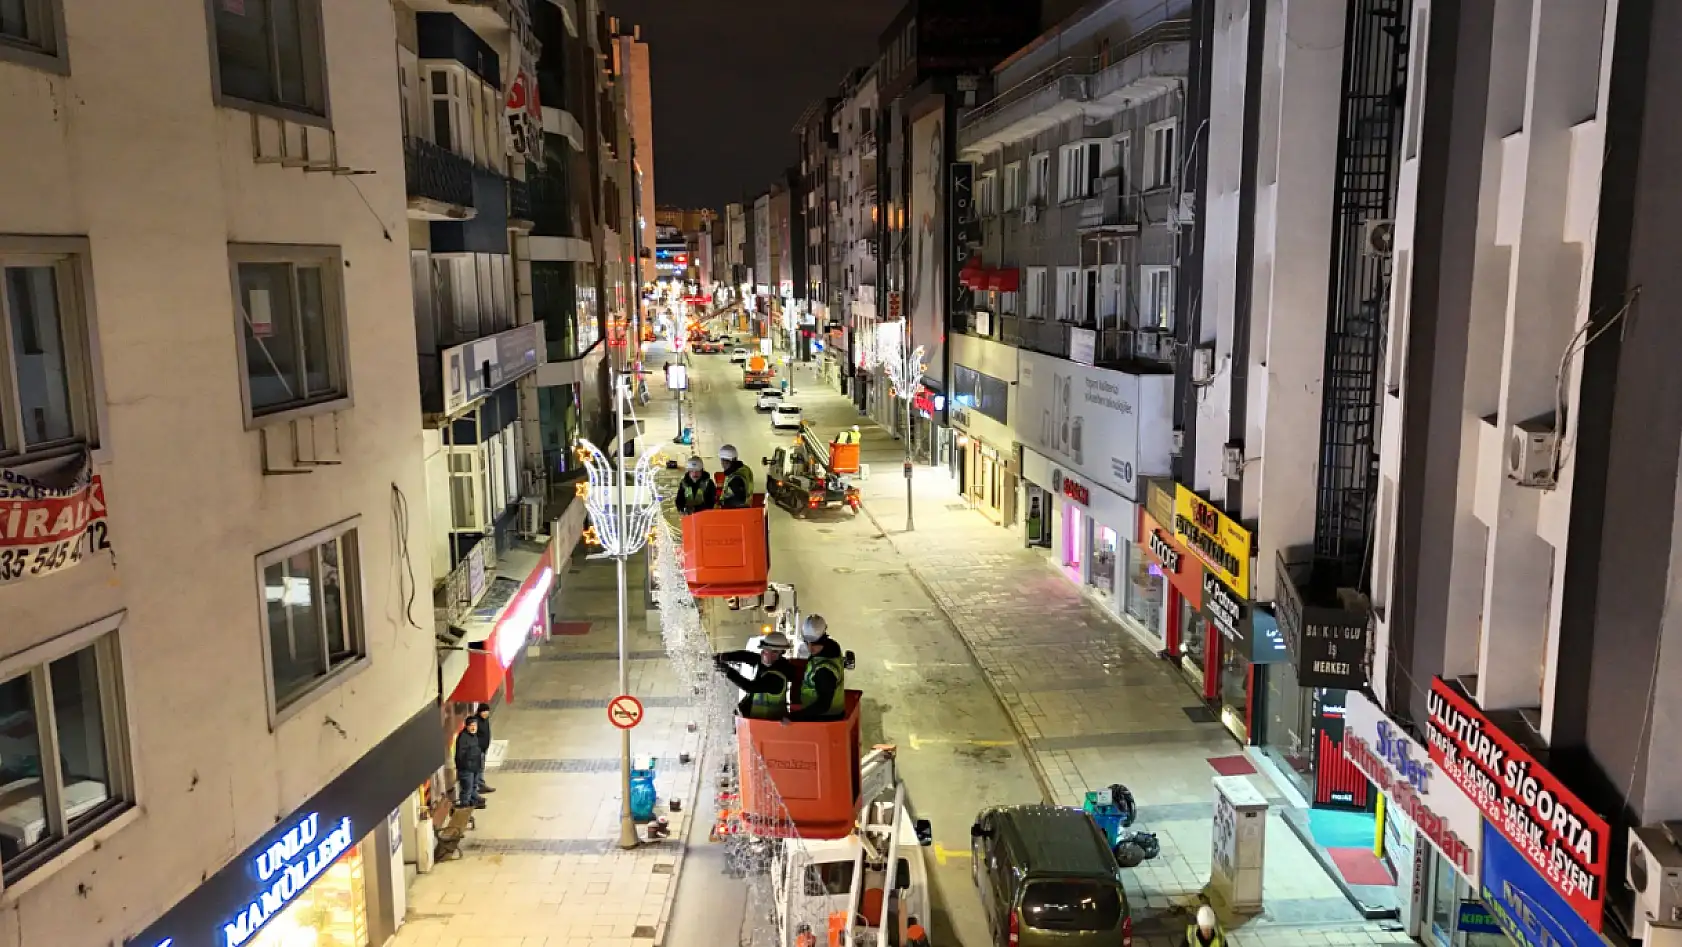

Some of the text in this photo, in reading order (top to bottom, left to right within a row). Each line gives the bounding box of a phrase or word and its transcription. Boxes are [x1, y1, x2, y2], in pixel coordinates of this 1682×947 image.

[954, 175, 970, 302] Kocaby
[1425, 721, 1457, 763] TRAFİK
[1463, 756, 1497, 801] KASKO
[1503, 796, 1544, 849] SAĞLIK
[1427, 689, 1504, 776] ULUTÜRK
[1504, 761, 1593, 864] SİGORTA
[1503, 880, 1562, 947] MET
